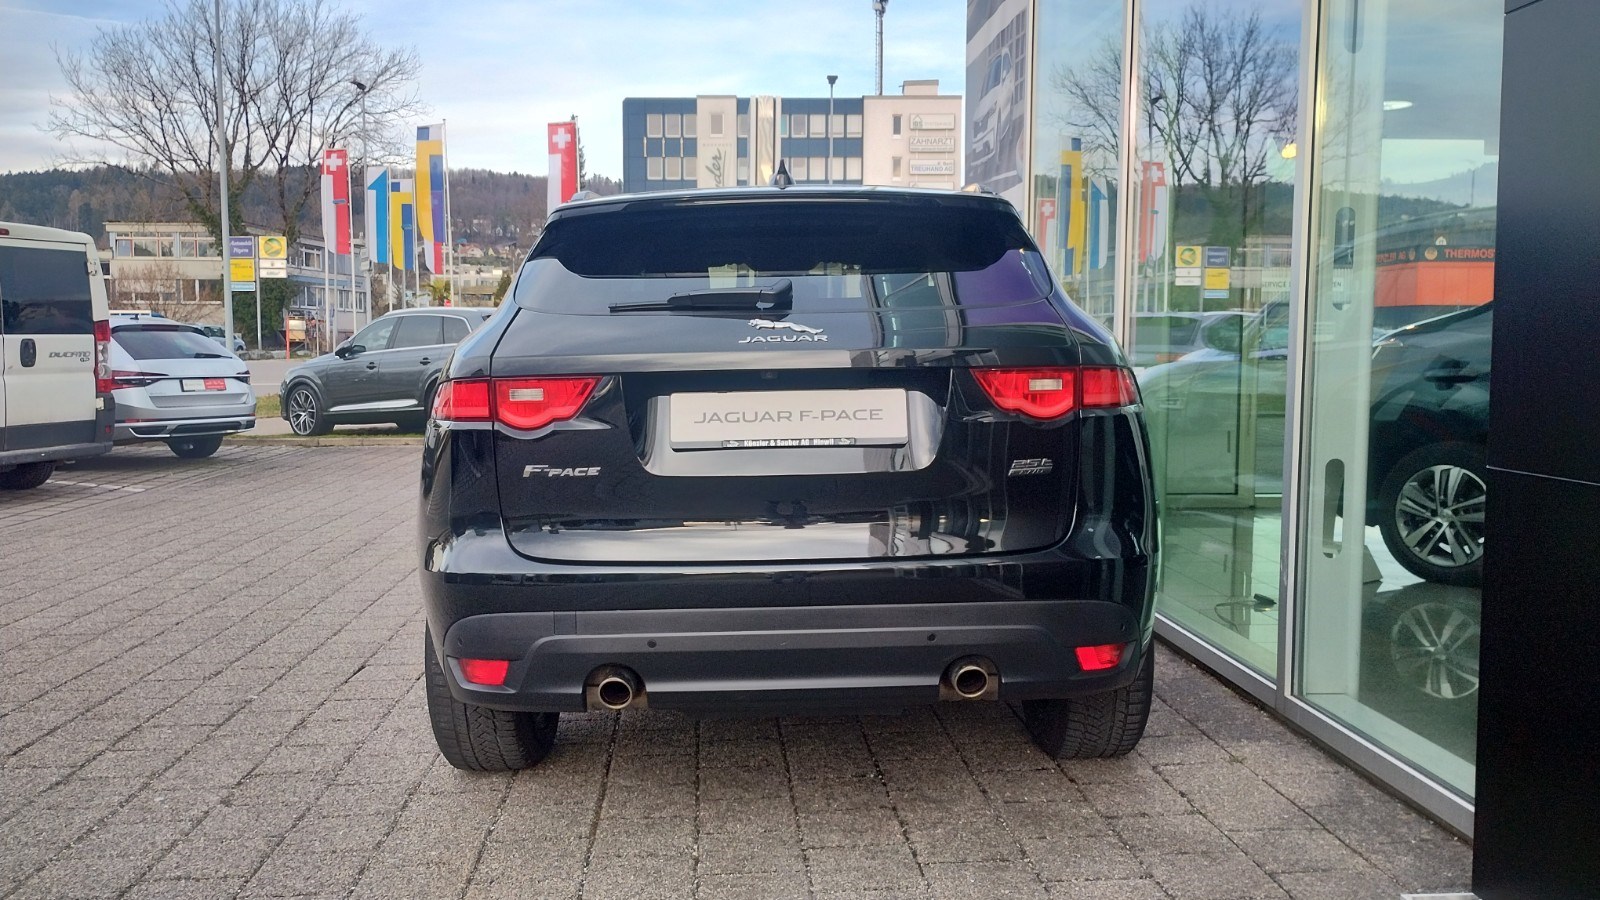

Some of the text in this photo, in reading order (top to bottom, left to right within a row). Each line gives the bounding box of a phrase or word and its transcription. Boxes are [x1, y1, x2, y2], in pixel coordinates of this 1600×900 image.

[911, 137, 952, 145] ZAHNARZT
[738, 334, 828, 344] JAGUAR
[693, 408, 883, 425] JAGUAR F-PACE
[744, 439, 769, 447] Künzler
[776, 439, 800, 447] Sauber
[800, 438, 810, 446] AG
[522, 464, 602, 478] F-PACE
